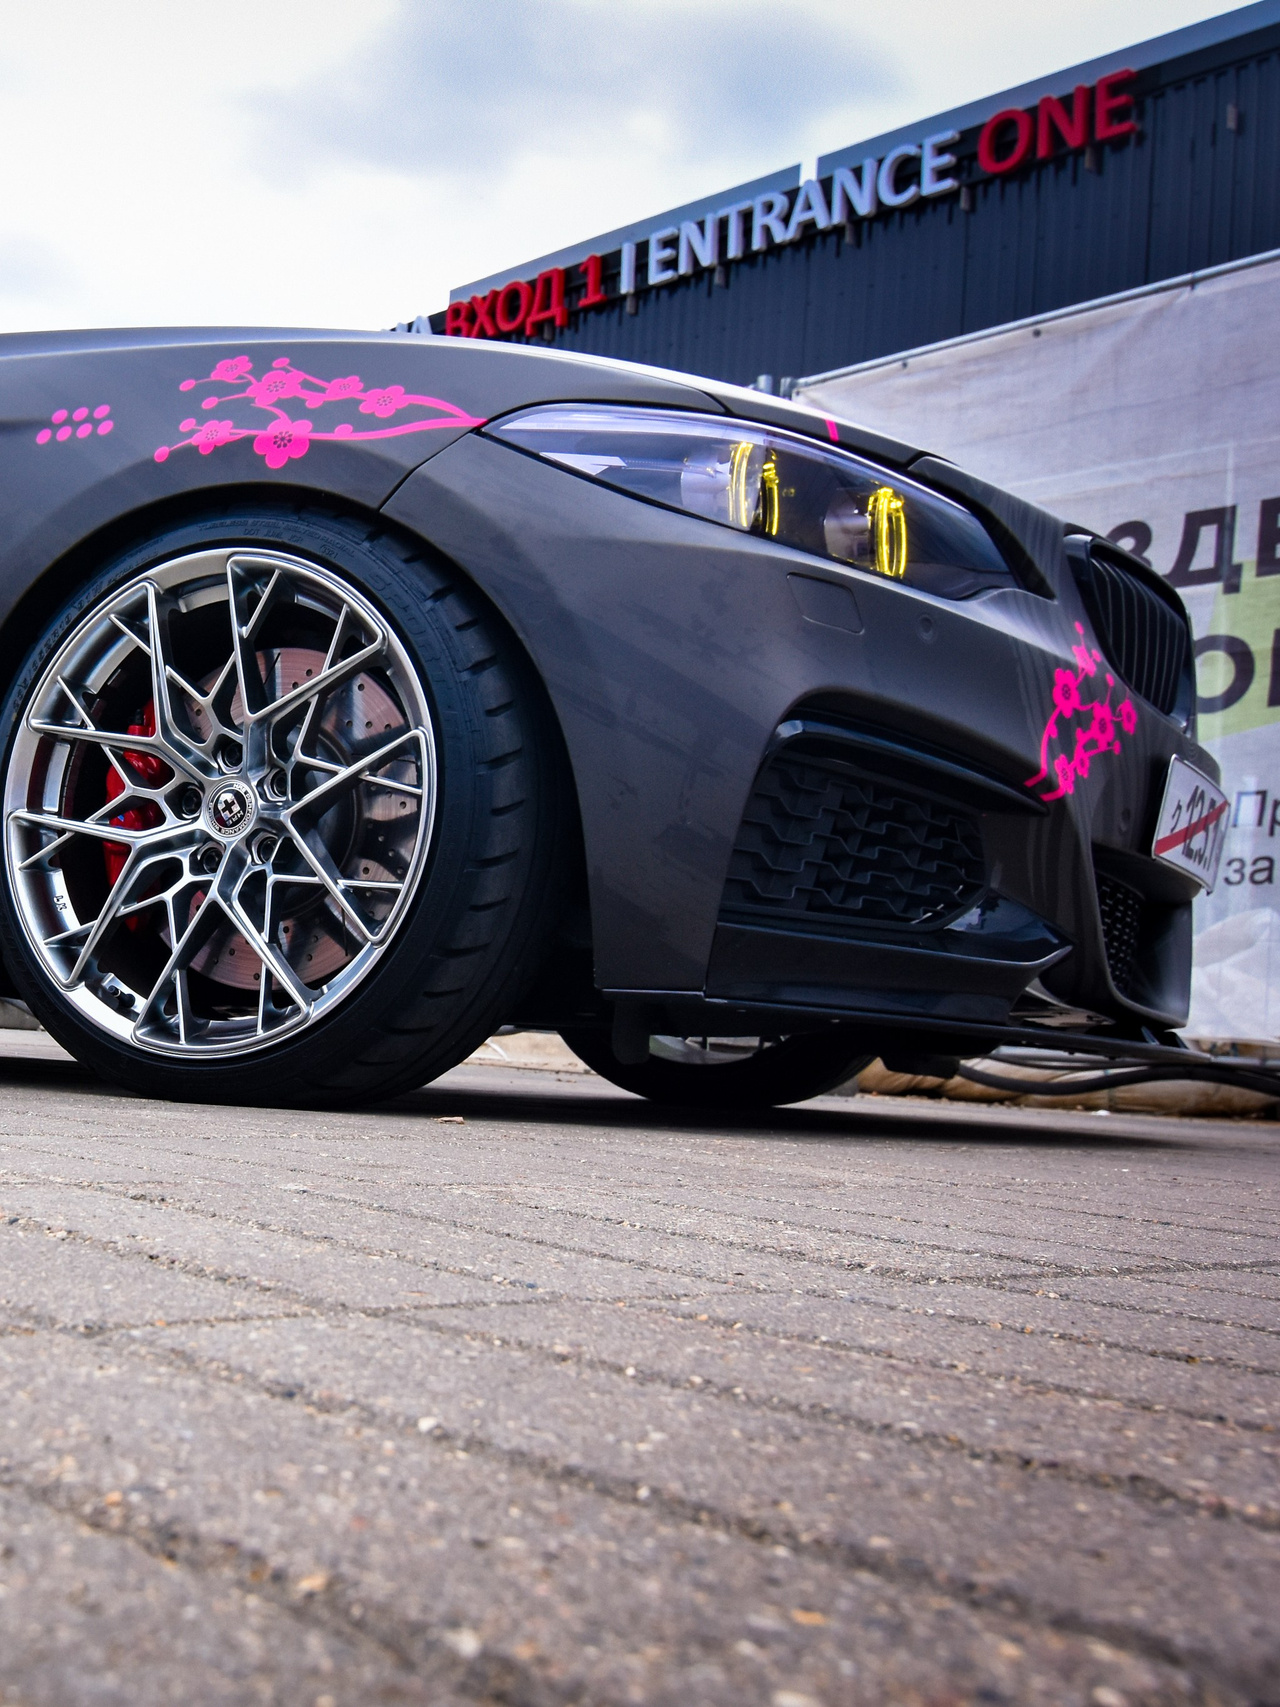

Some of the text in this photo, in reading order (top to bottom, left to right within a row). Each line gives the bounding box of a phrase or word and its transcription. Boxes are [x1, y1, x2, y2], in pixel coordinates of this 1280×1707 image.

[445, 266, 568, 337] ВХОД
[578, 254, 608, 307] 1
[647, 129, 960, 286] ENTRANCE
[977, 67, 1138, 174] ONE
[243, 528, 260, 536] DOT
